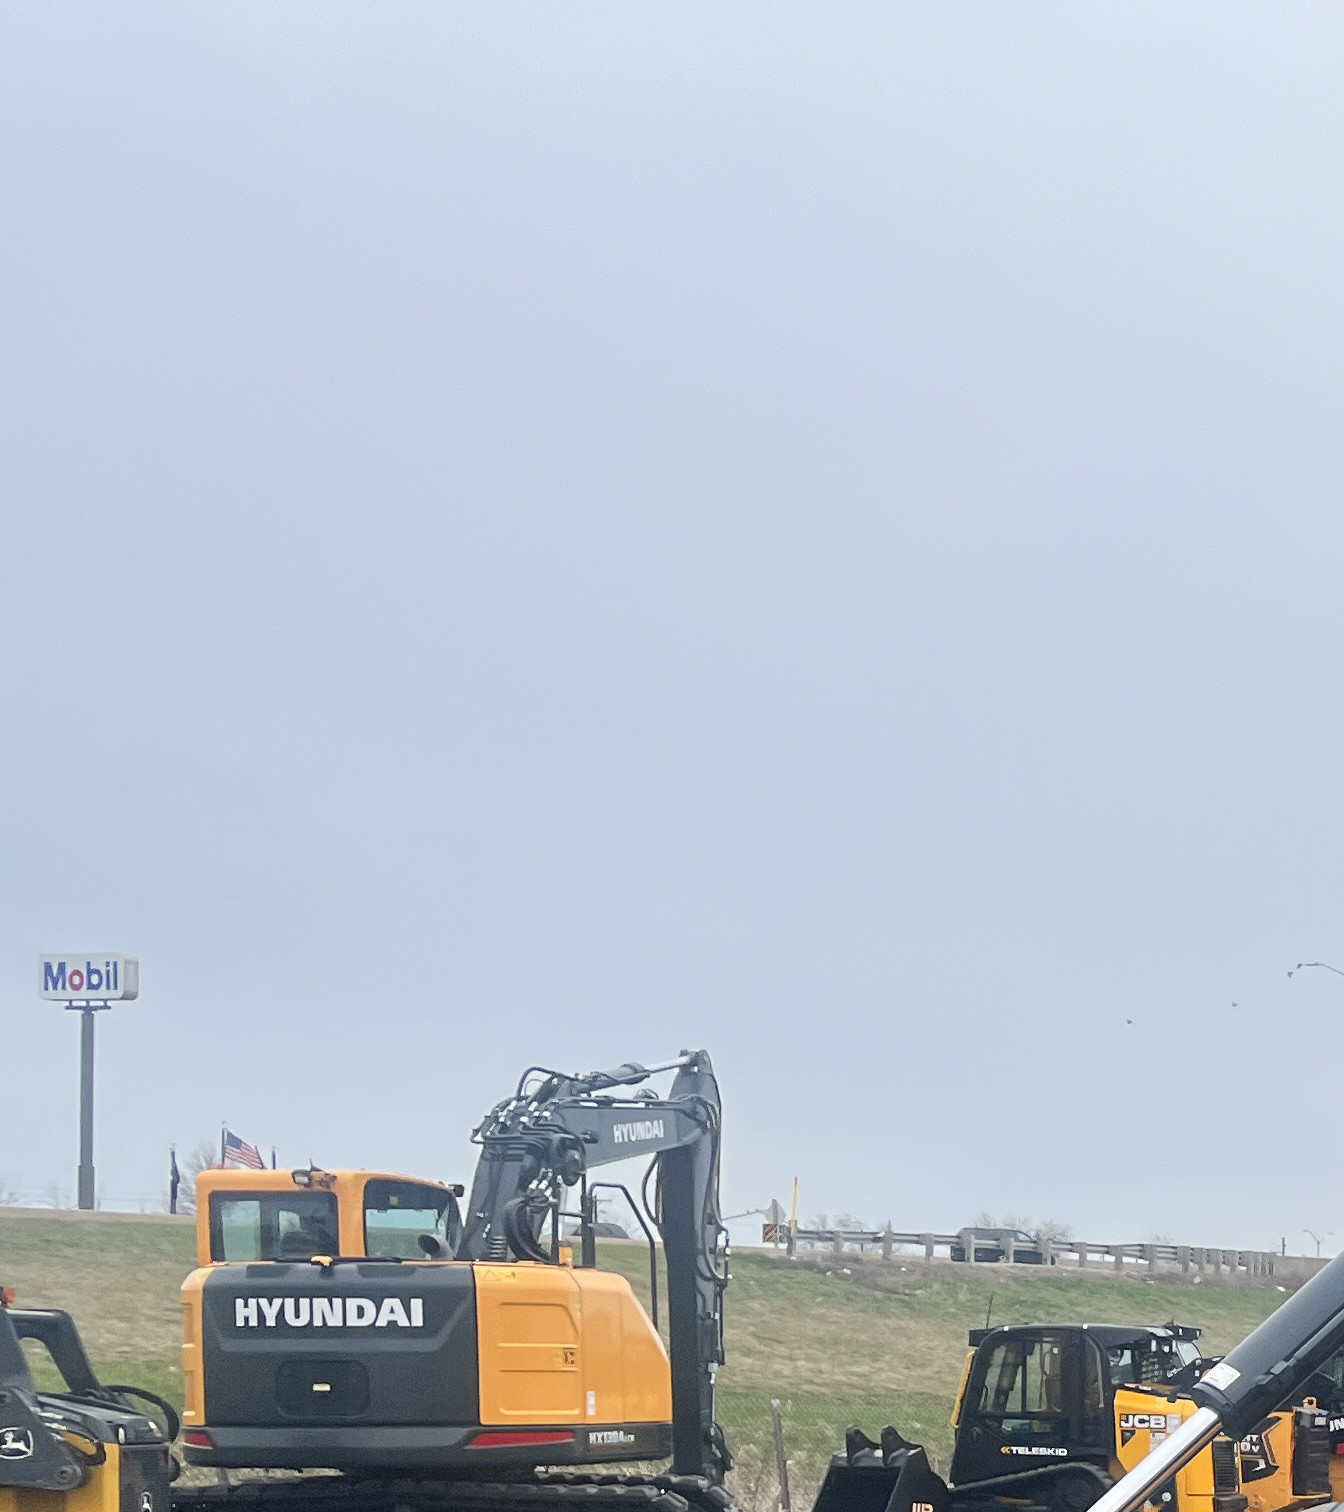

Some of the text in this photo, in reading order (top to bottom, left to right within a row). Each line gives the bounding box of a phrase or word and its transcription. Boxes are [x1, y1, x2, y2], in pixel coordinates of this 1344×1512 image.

[43, 960, 119, 991] Mobil
[613, 1119, 664, 1144] HYUNDAI
[235, 1297, 424, 1327] HYUNDAI
[1120, 1414, 1166, 1429] JCB
[1010, 1446, 1068, 1457] TELESKID
